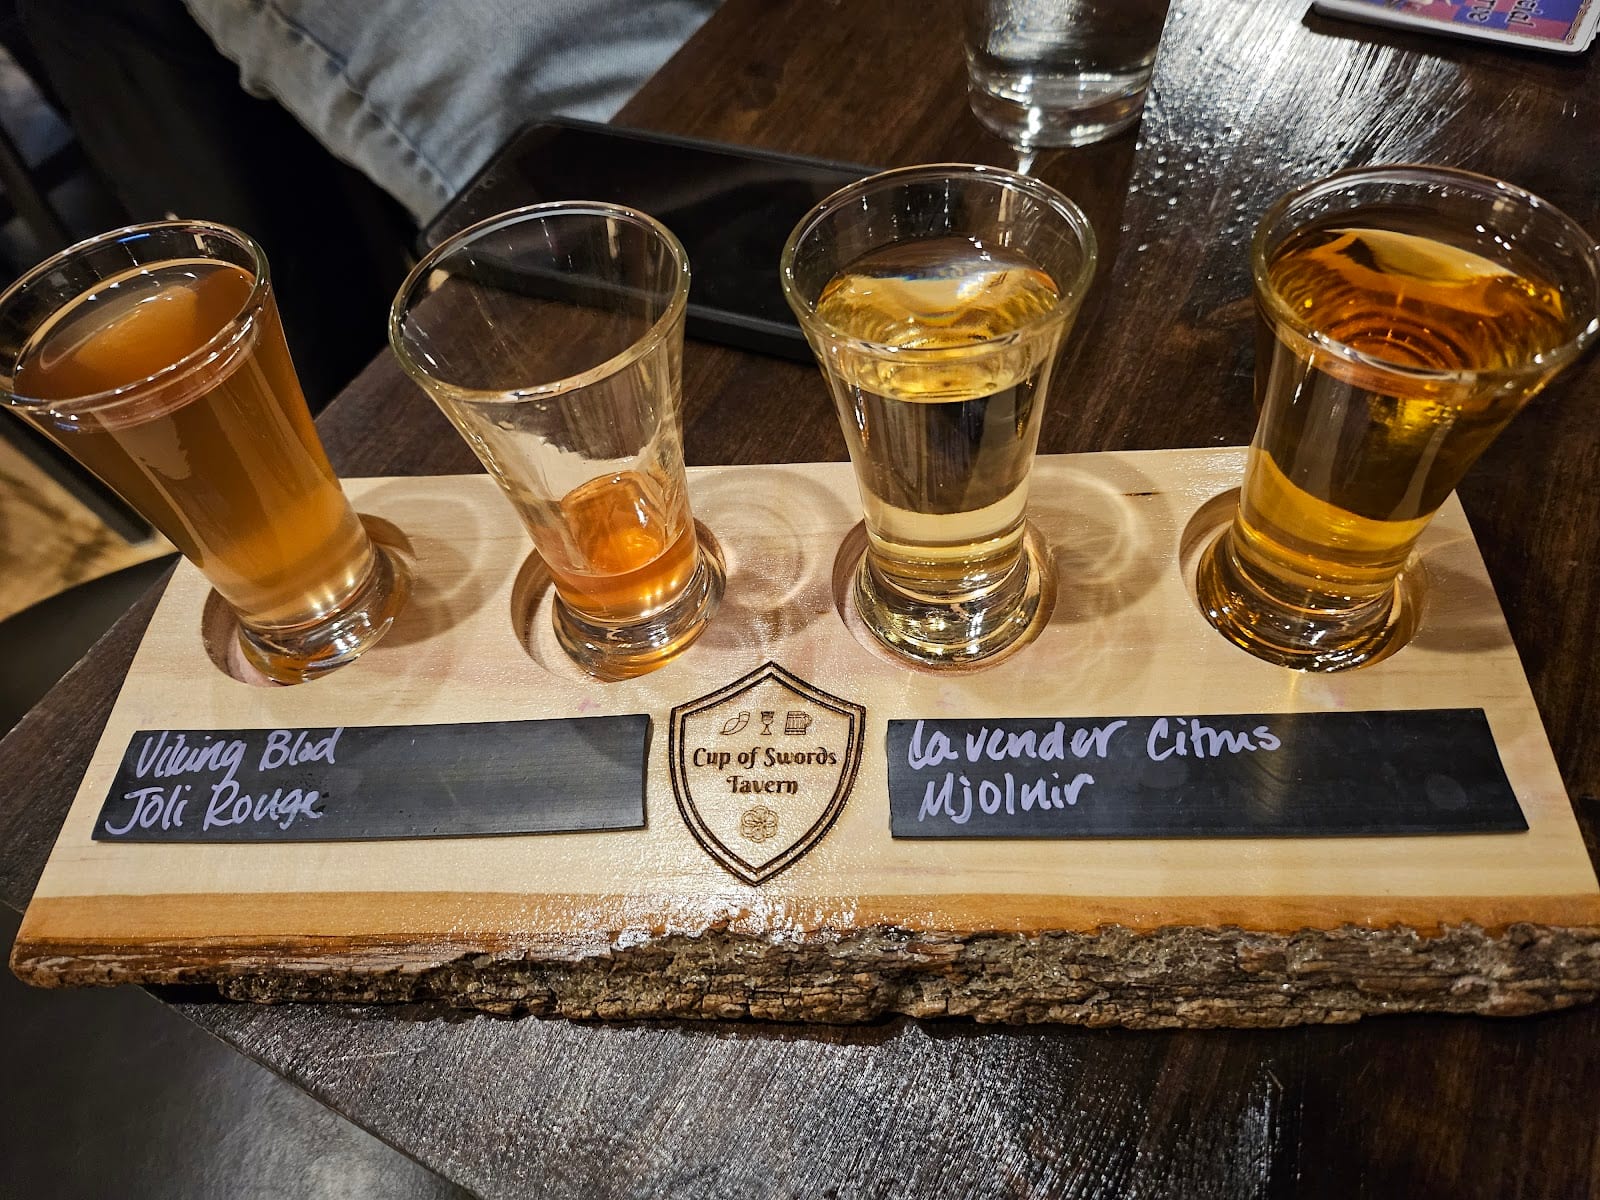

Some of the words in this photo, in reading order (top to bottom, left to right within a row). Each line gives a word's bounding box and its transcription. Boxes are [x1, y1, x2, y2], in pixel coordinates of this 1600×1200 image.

[693, 747, 731, 770] Cup
[737, 746, 761, 769] of
[763, 746, 838, 768] Swords
[1146, 717, 1281, 761] Citrus
[725, 774, 799, 795] Tavern
[918, 771, 1095, 825] Mjolnir
[104, 784, 192, 835] Joli
[202, 779, 324, 831] Rouge
